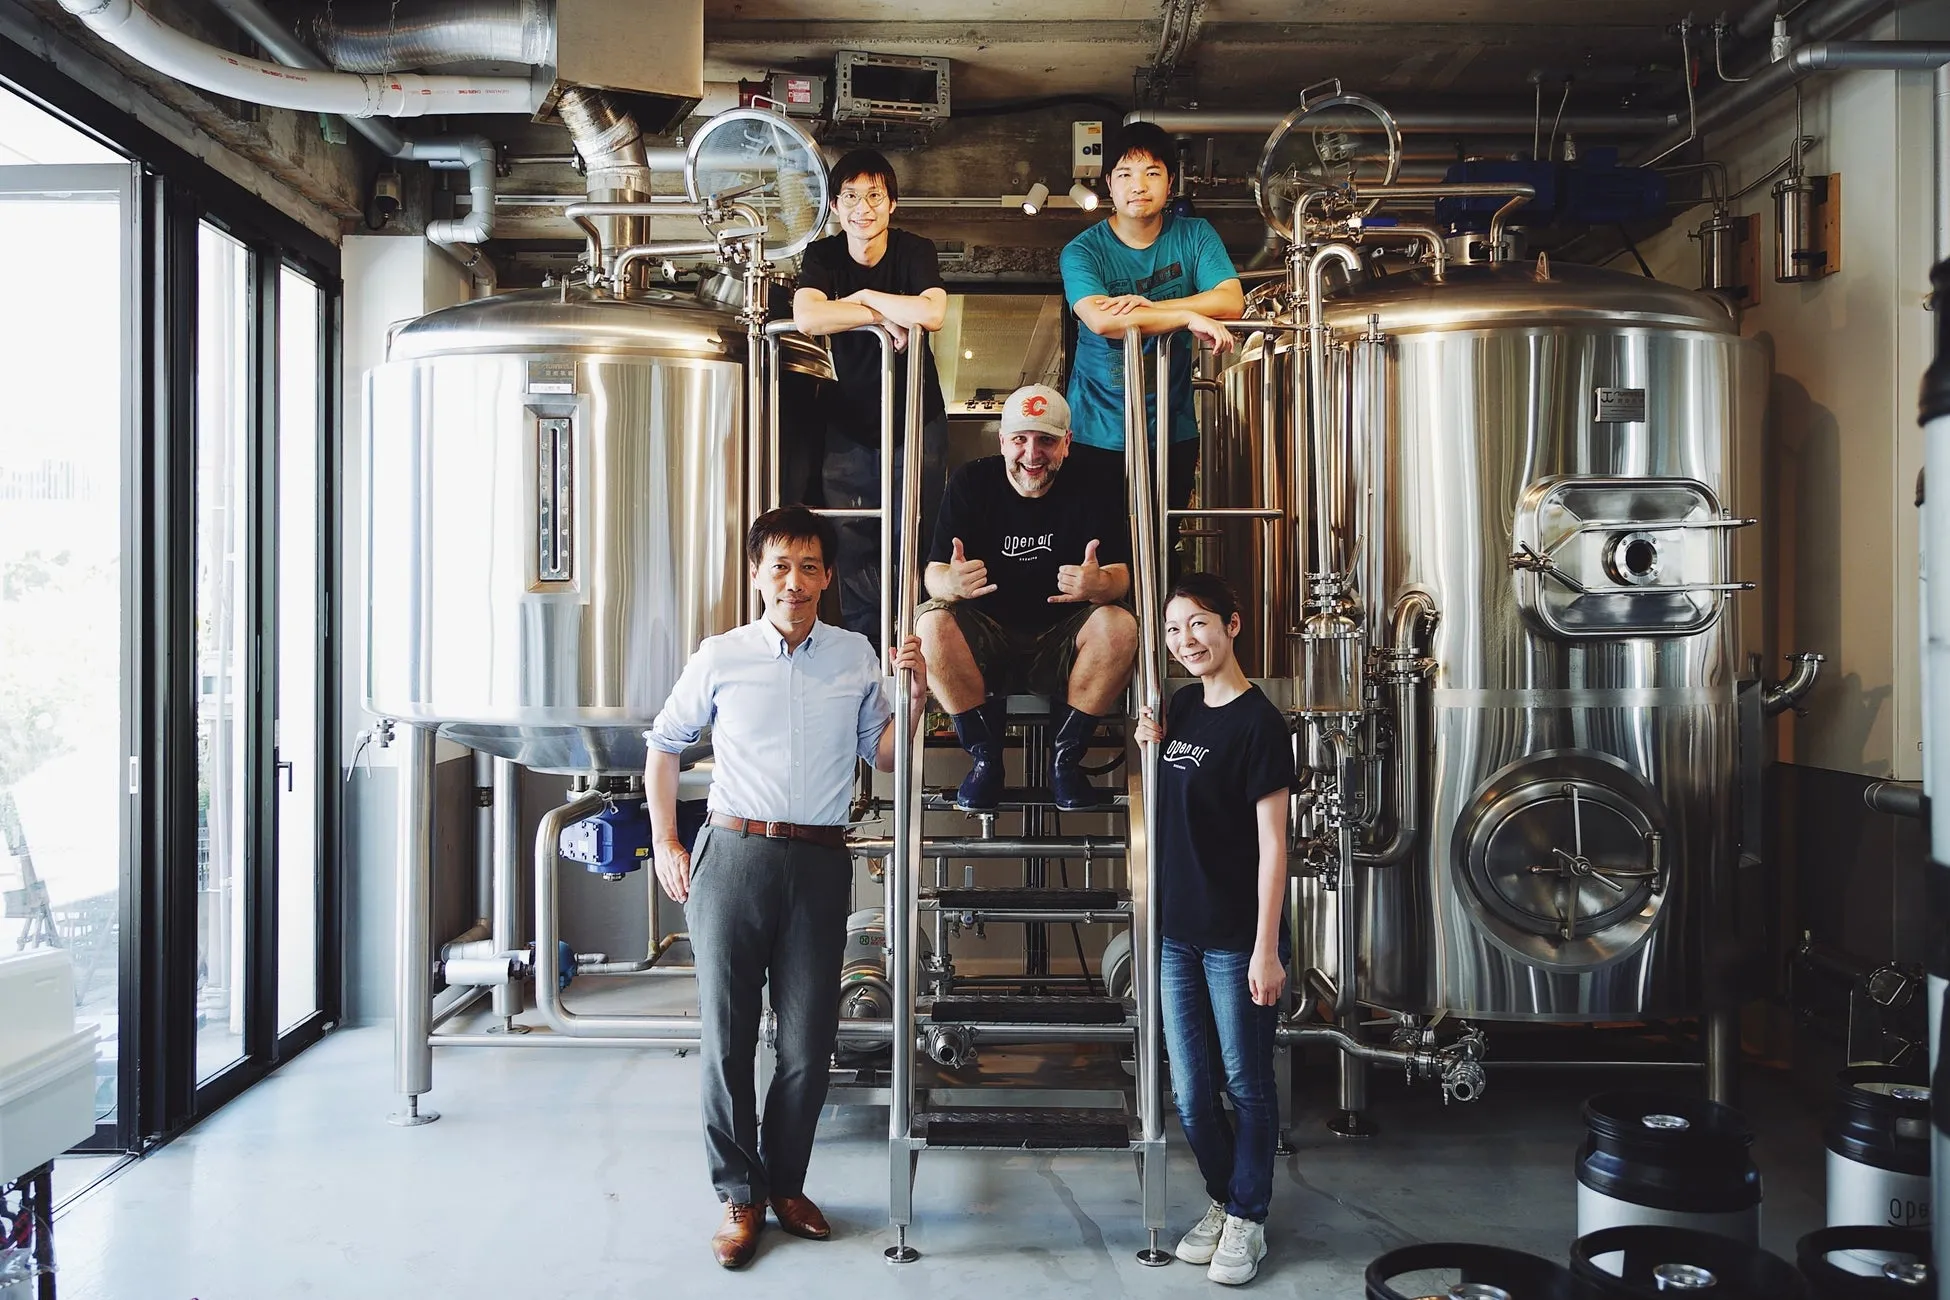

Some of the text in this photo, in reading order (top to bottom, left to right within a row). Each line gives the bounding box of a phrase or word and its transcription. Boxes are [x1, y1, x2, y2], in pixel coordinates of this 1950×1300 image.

[1023, 395, 1048, 417] C
[1037, 533, 1054, 547] air
[1191, 745, 1210, 762] air
